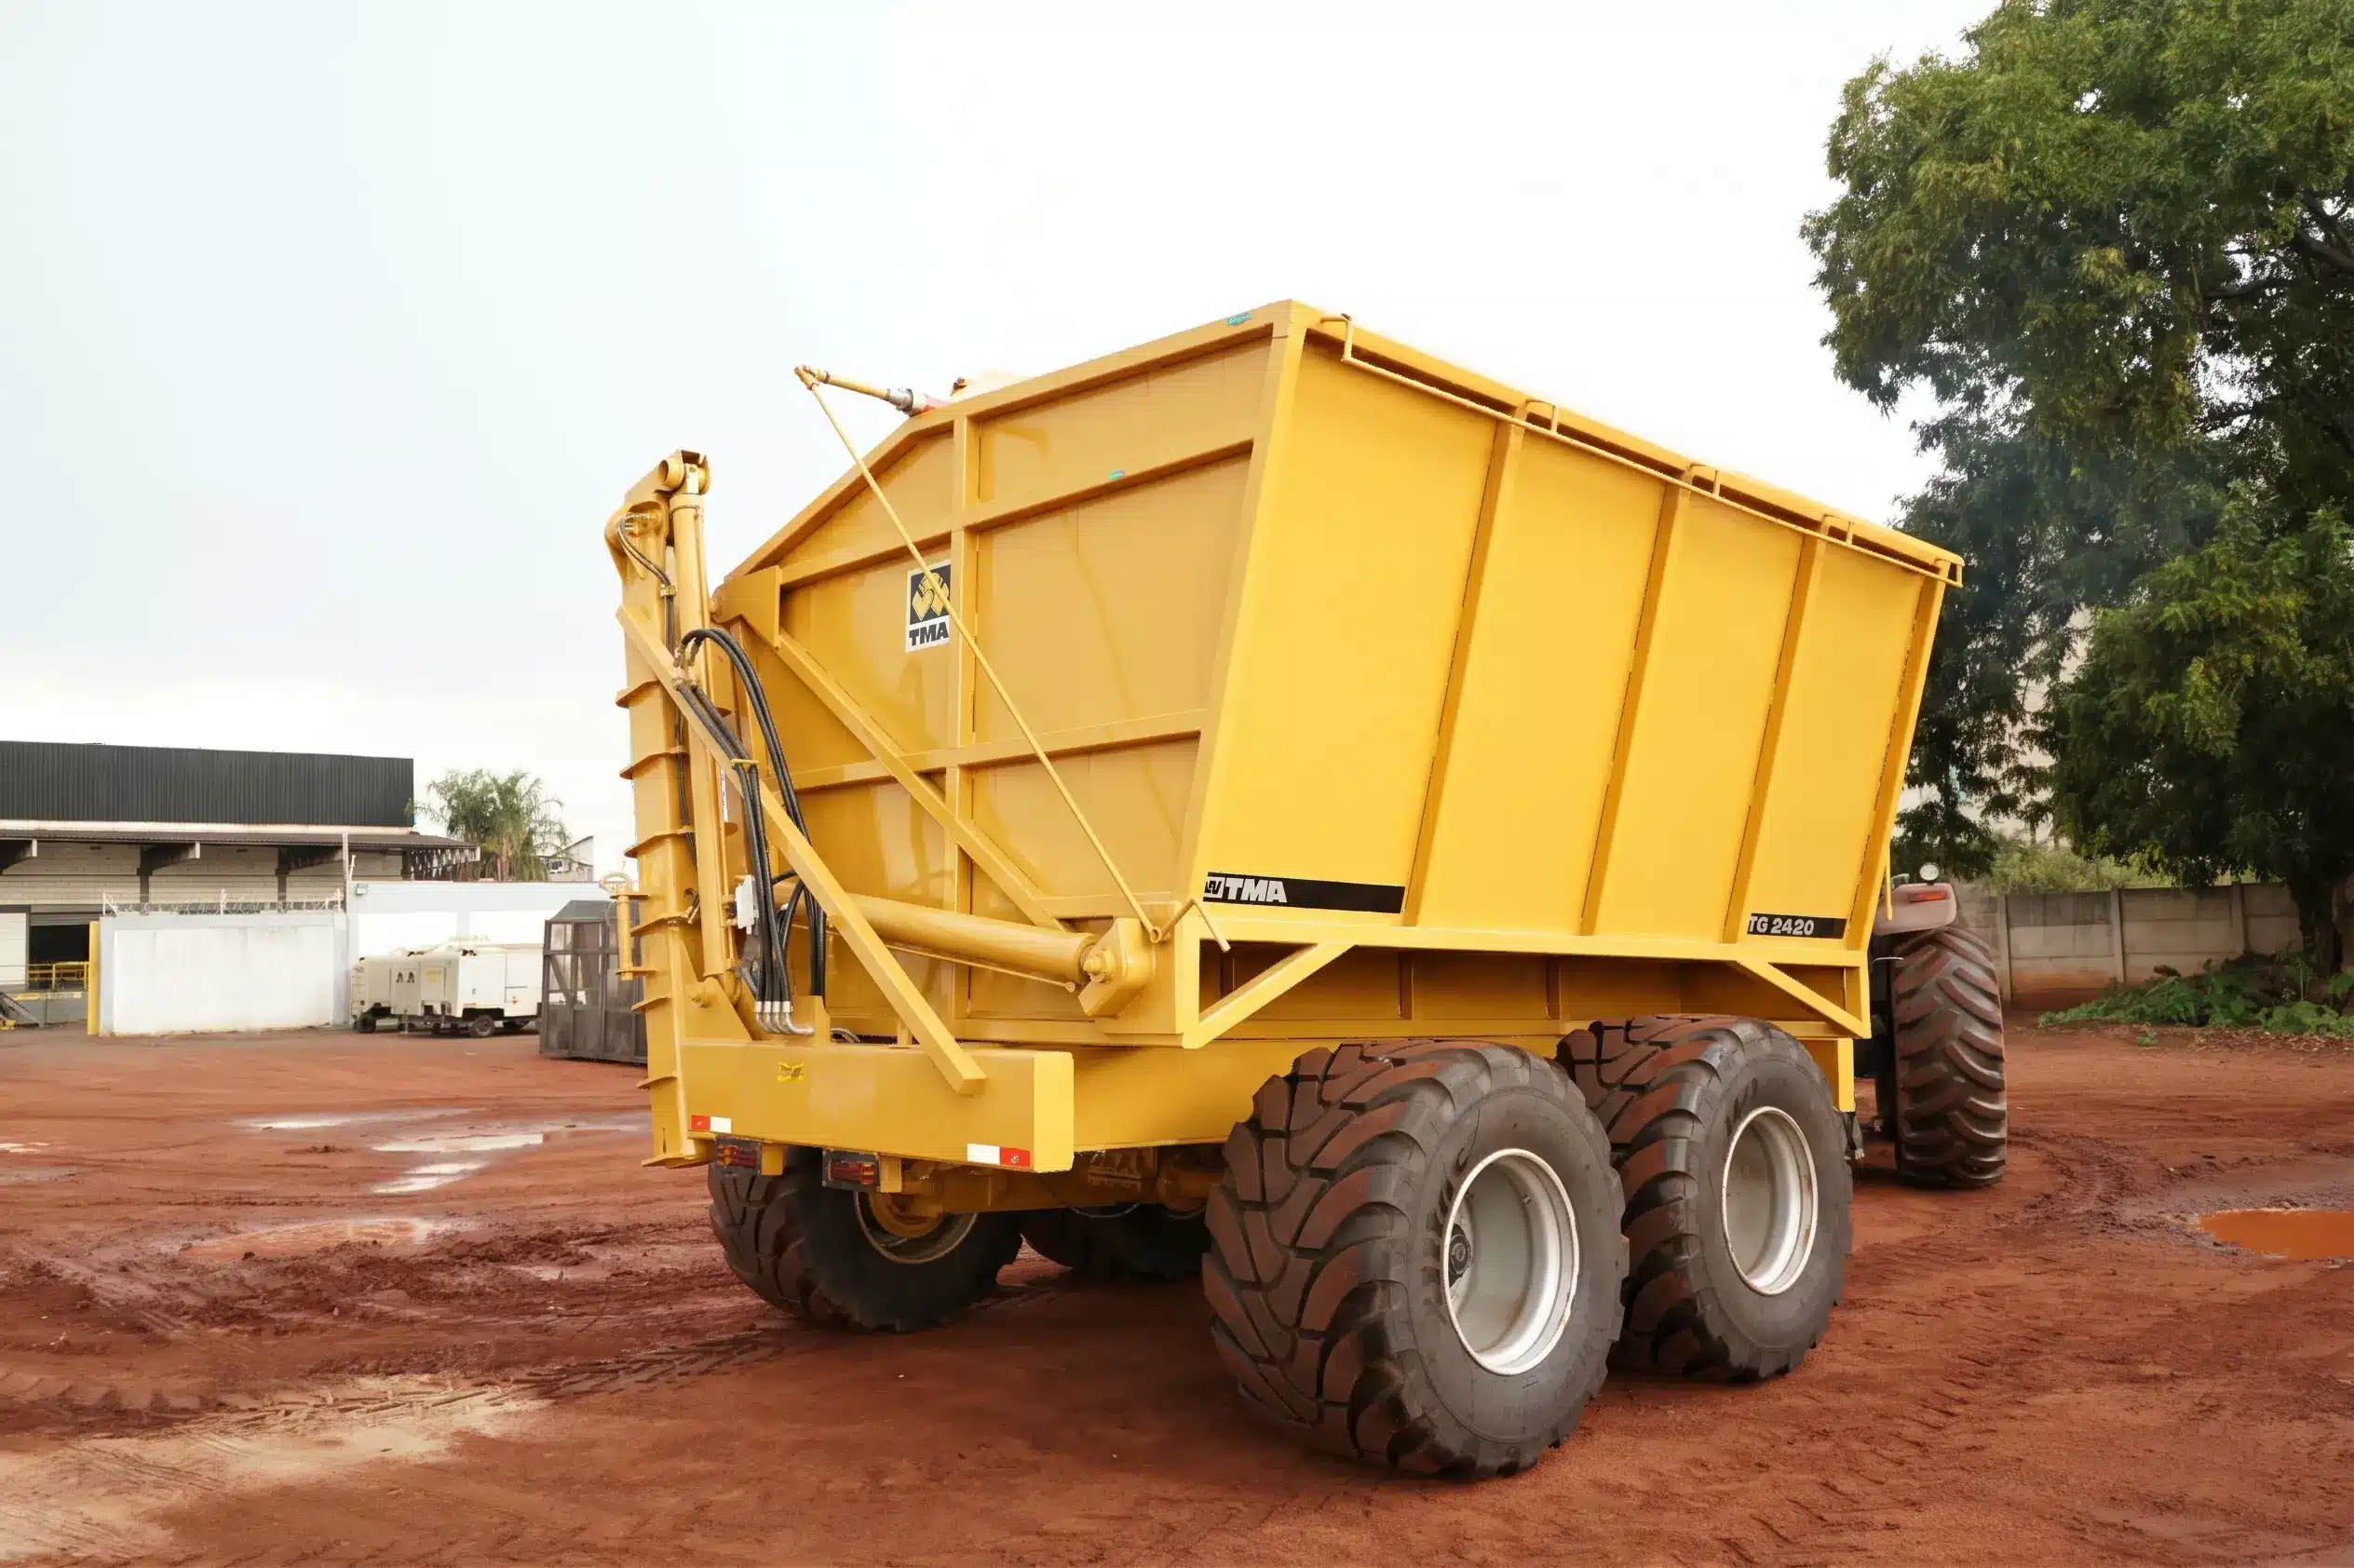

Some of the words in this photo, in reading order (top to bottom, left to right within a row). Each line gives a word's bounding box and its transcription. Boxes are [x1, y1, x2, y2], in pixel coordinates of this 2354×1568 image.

[909, 621, 949, 646] TMA
[1225, 877, 1288, 903] TMA
[1749, 916, 1768, 933] TG
[1770, 917, 1815, 936] 2420
